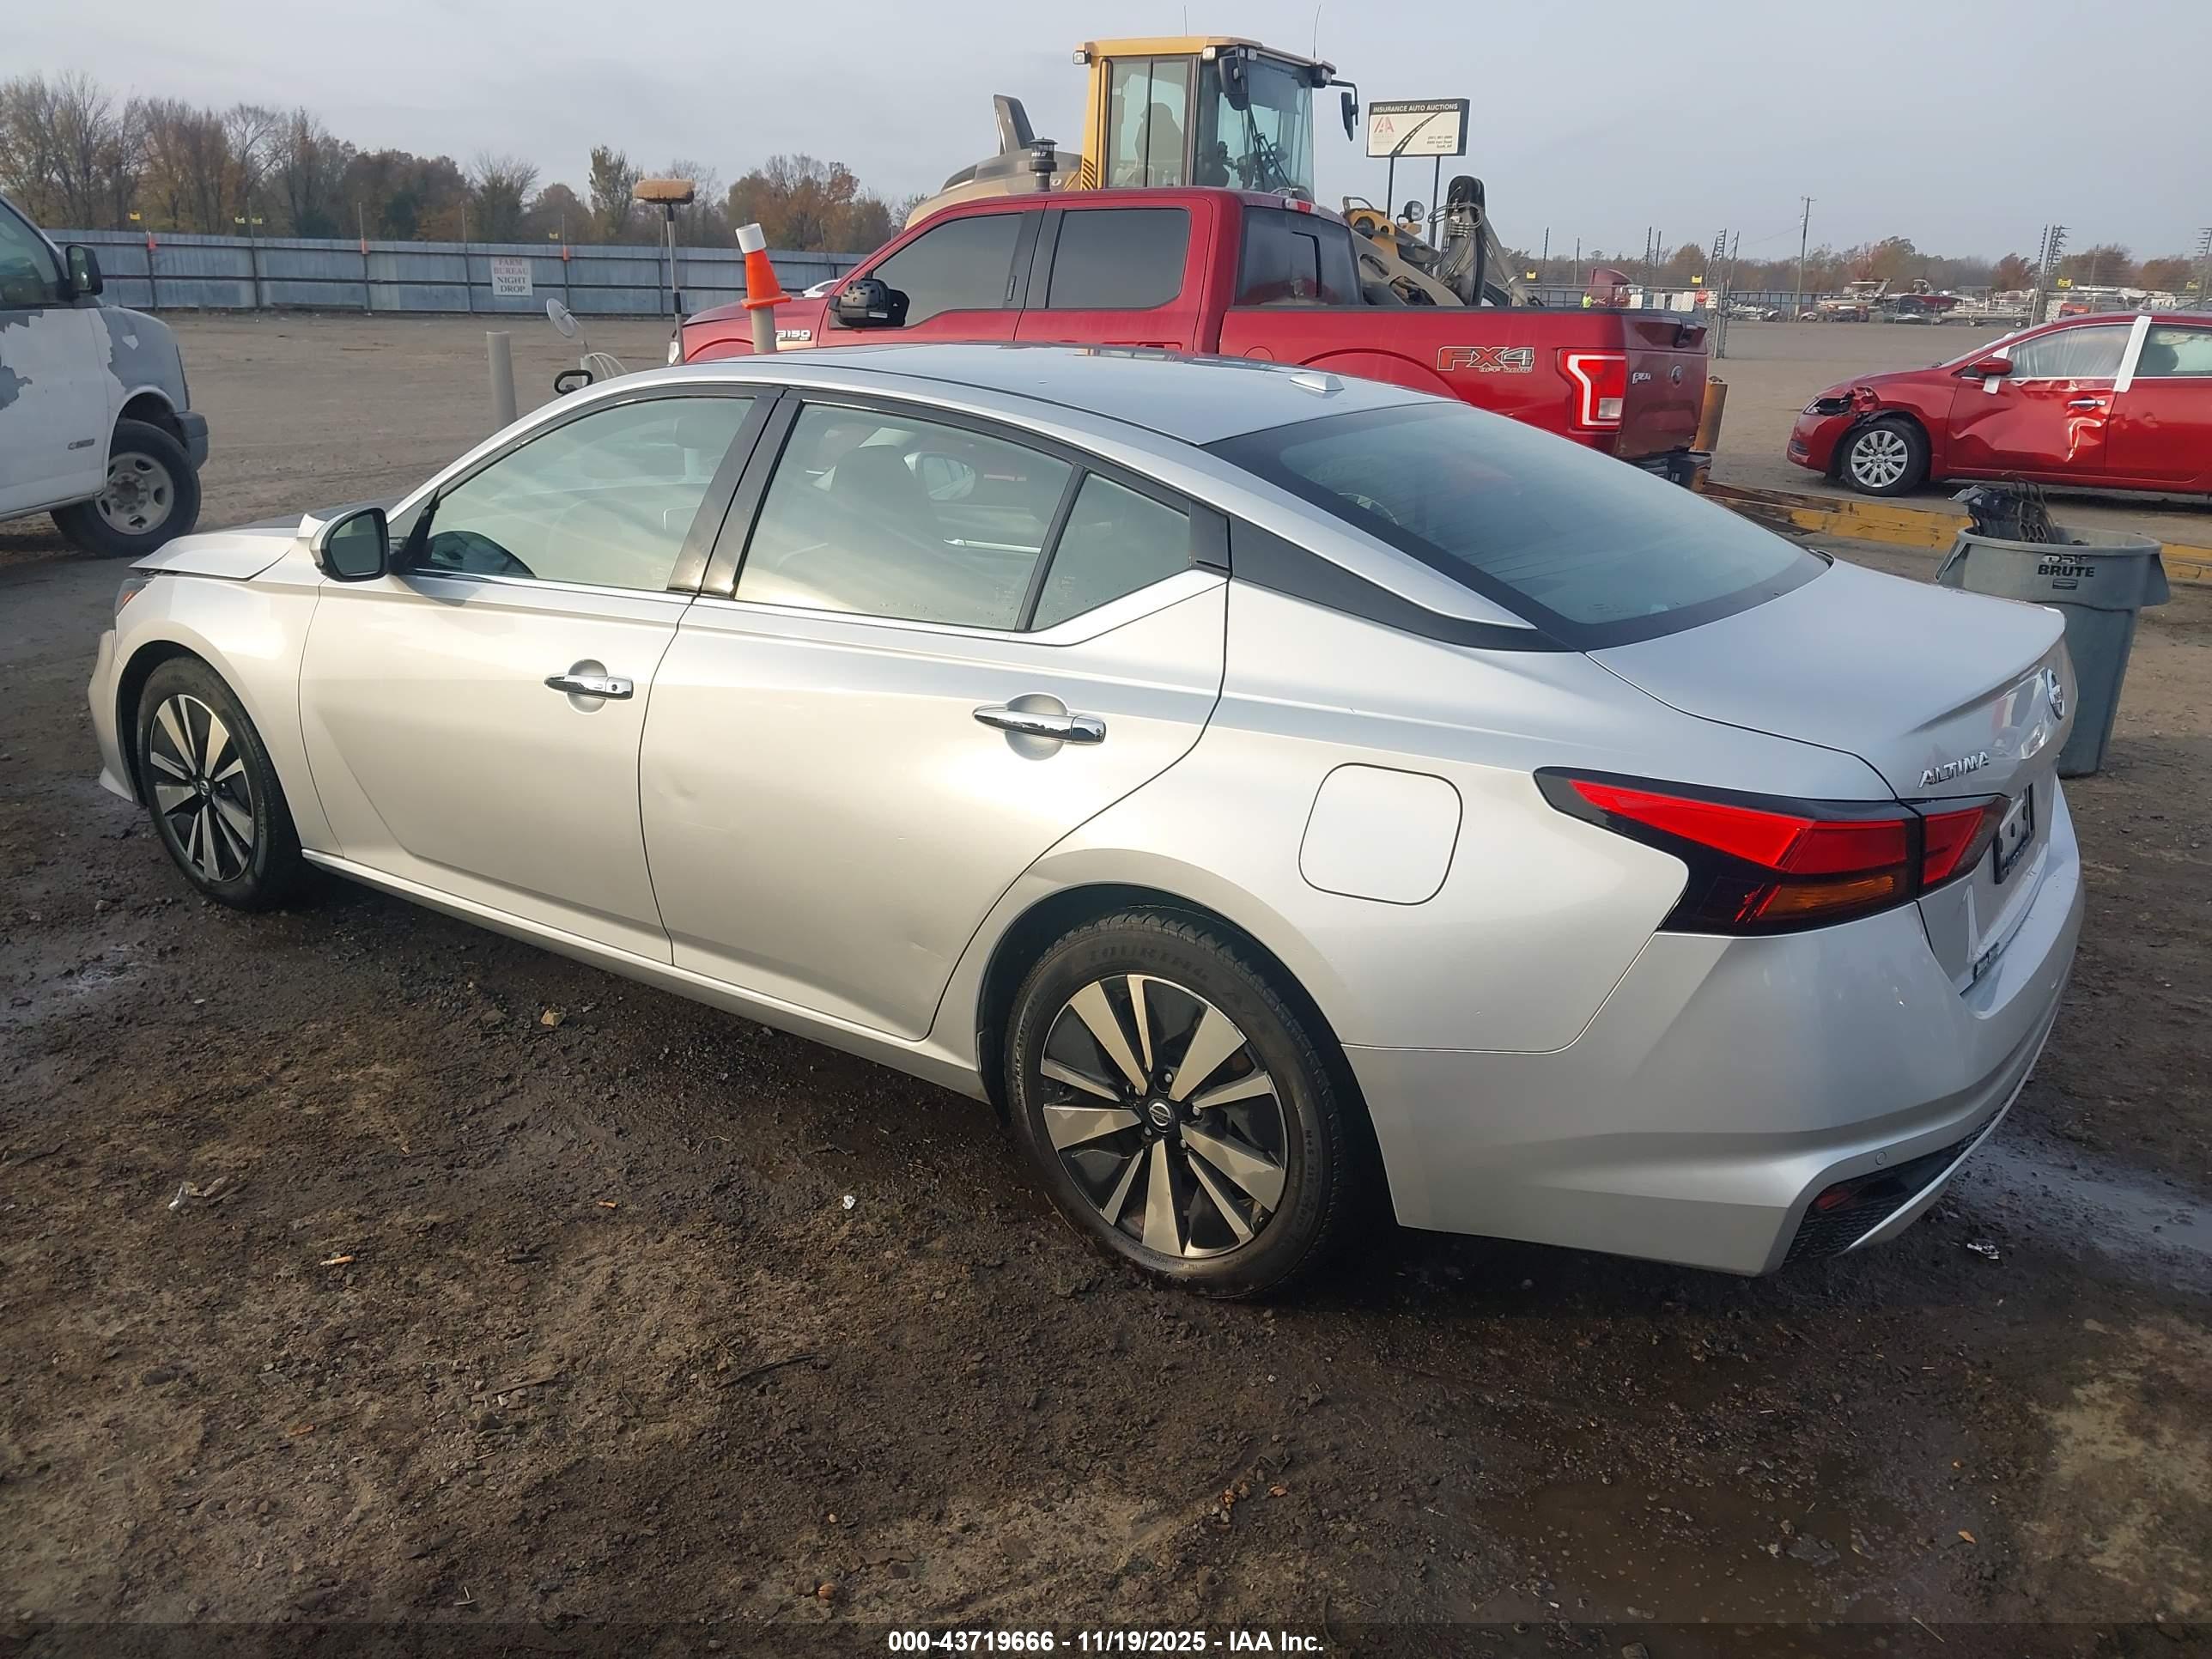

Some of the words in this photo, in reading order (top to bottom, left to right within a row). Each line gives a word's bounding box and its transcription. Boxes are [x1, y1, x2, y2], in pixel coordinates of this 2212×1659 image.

[1437, 346, 1534, 371] FX4
[2038, 564, 2095, 578] BRUTE
[1917, 751, 1990, 788] ALTIMA
